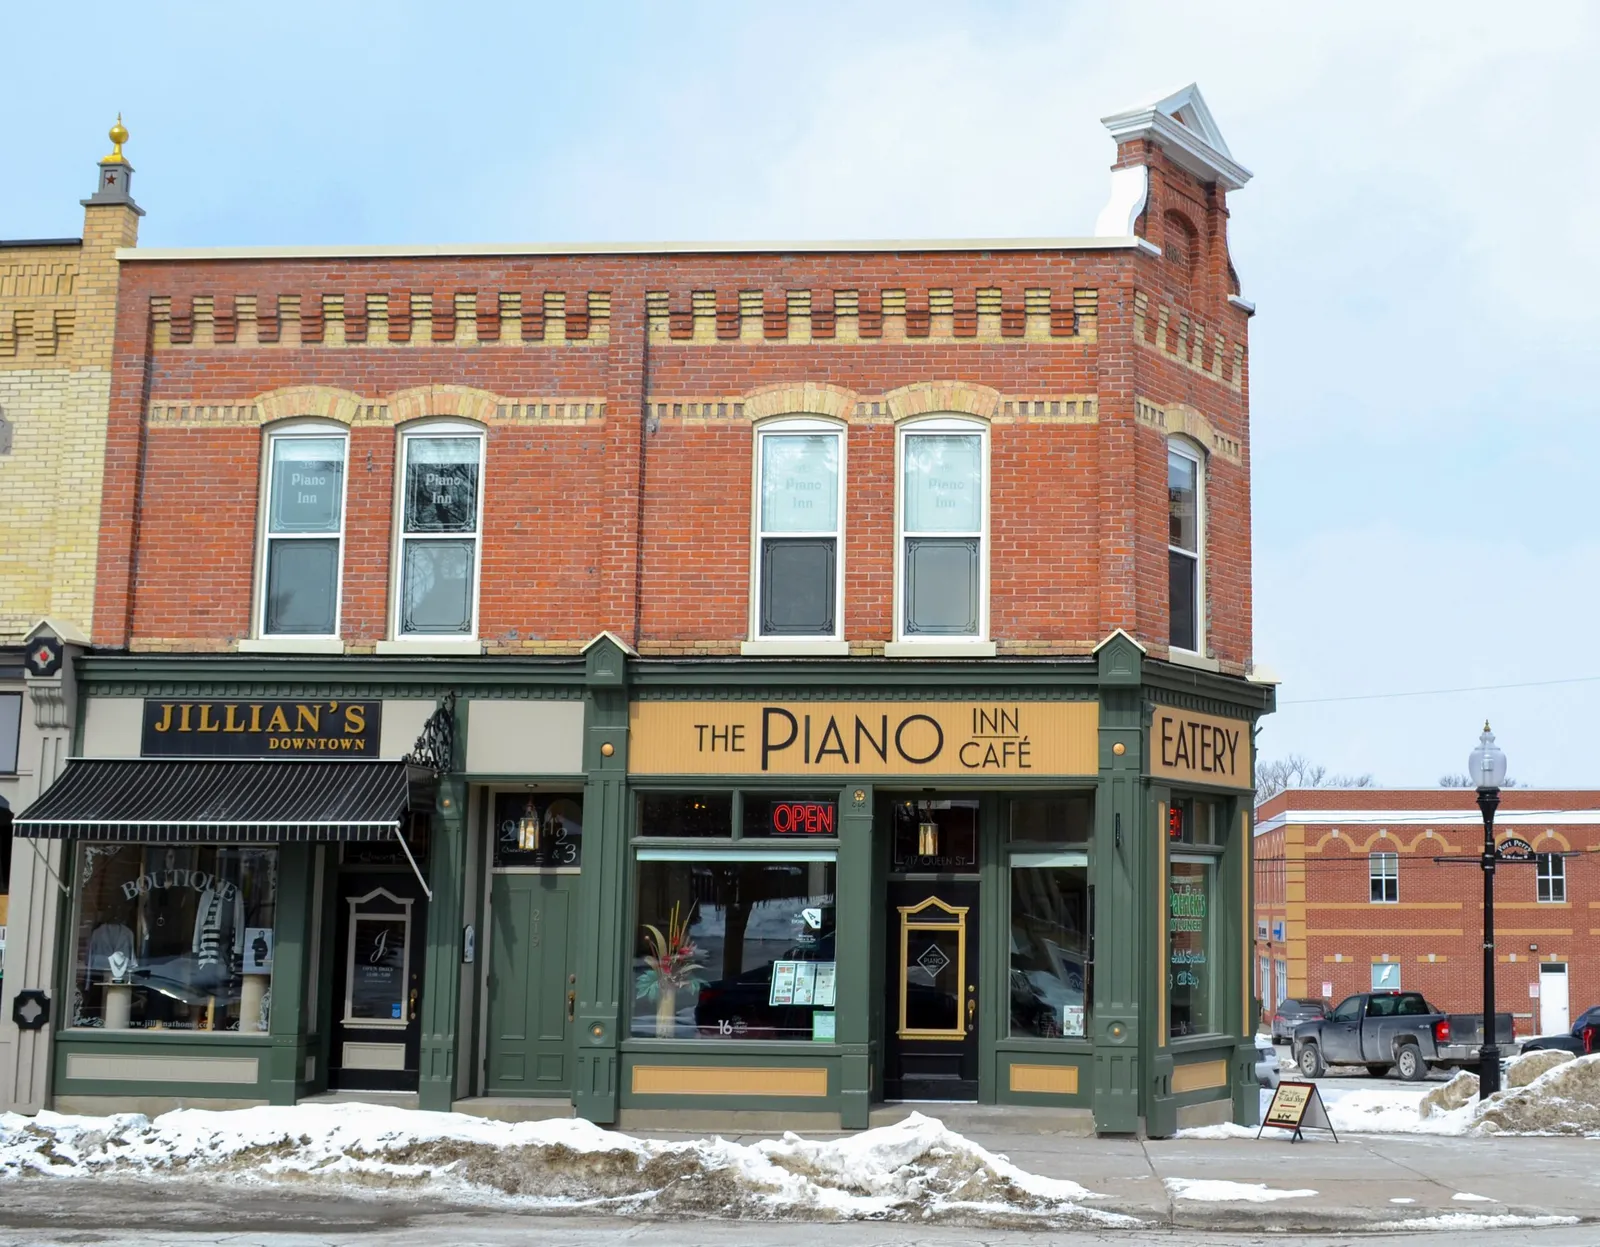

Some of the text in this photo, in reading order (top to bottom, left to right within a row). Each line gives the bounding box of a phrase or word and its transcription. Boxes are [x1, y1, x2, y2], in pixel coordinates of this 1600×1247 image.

[291, 473, 326, 486] Piano
[424, 473, 460, 486] Piano
[785, 478, 822, 491] Piano
[297, 492, 317, 504] Inn
[432, 492, 452, 504] Inn
[792, 497, 813, 509] Inn
[935, 496, 956, 508] Inn
[155, 701, 366, 733] JILLIAN'S
[973, 708, 1018, 734] INN
[269, 738, 366, 750] DOWNTOWN
[694, 707, 944, 770] THE PIANO
[959, 736, 1031, 768] CAFÉ
[1162, 717, 1239, 775] EATERY
[773, 804, 833, 833] OPEN
[1498, 840, 1532, 852] Port Perry
[563, 843, 577, 864] 3
[922, 855, 953, 866] QUEEN
[121, 868, 238, 901] BOUTIQUE
[718, 1020, 733, 1034] 16
